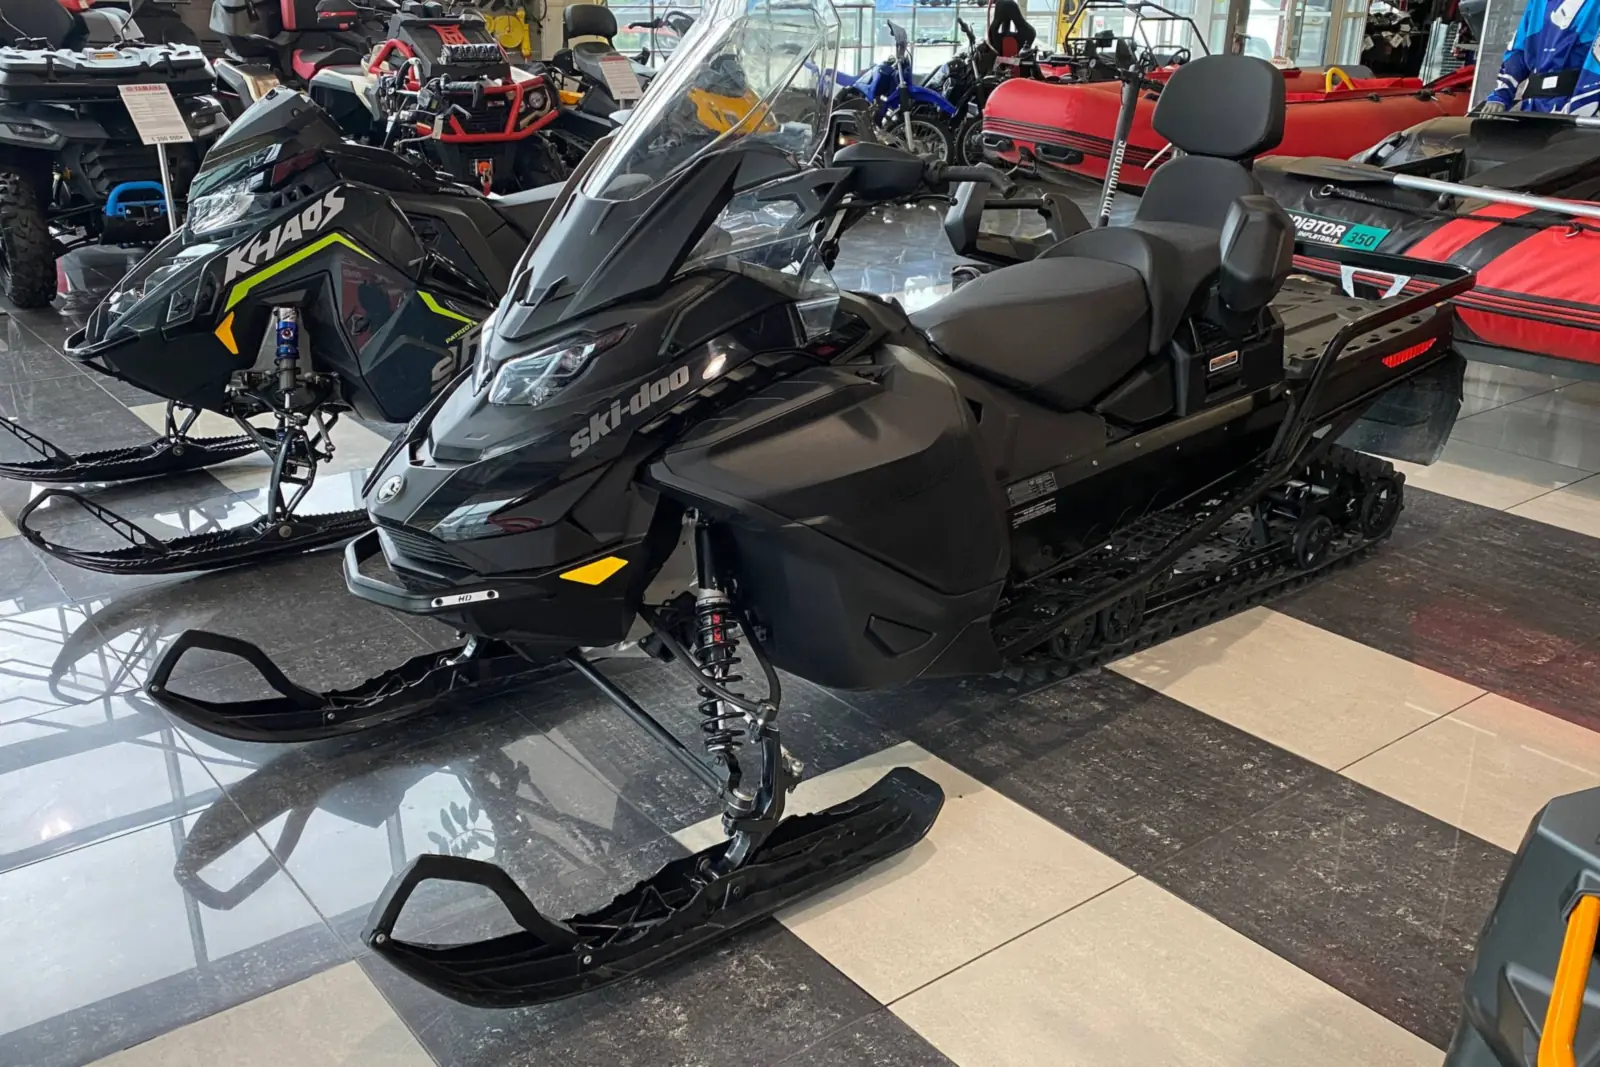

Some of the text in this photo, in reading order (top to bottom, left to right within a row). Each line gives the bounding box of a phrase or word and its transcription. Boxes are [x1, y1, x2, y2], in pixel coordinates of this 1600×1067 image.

[224, 185, 346, 287] KHAOS
[1297, 230, 1340, 244] INFLATABLE
[1347, 231, 1377, 248] 350
[569, 365, 690, 458] ski-doo
[458, 594, 472, 603] HD
